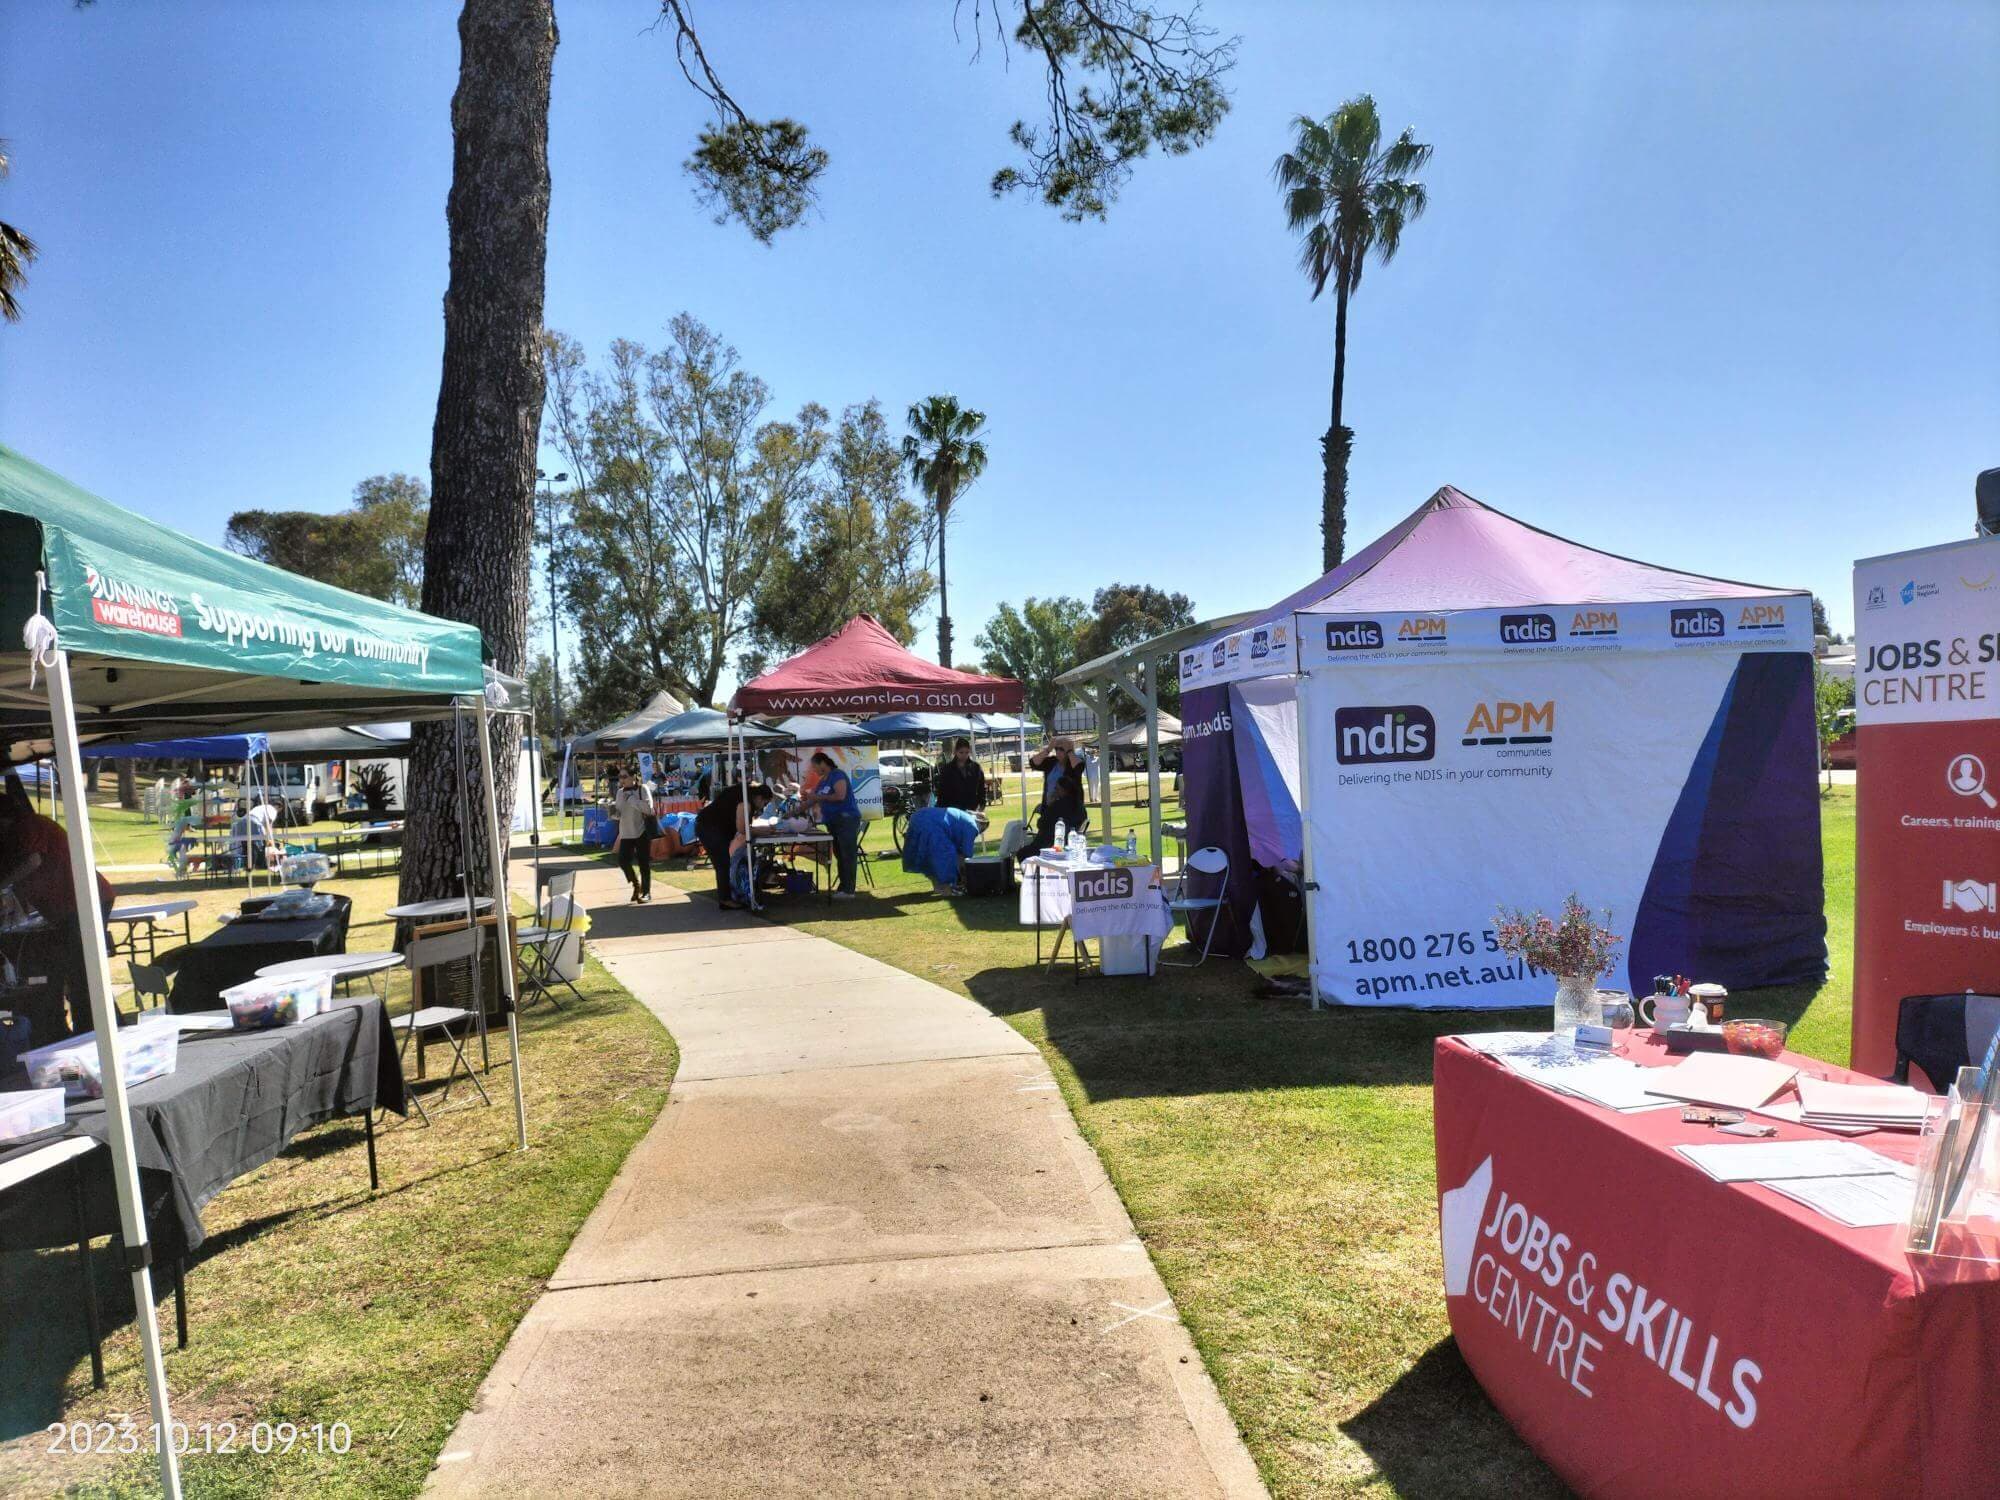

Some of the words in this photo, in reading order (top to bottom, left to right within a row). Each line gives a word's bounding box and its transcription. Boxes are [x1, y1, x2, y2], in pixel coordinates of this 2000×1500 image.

[98, 602, 178, 633] warehouse
[1571, 610, 1618, 629] APM
[1675, 611, 1721, 634] ndis
[1740, 605, 1784, 623] APM
[191, 592, 316, 658] Supporting
[320, 628, 349, 653] our
[353, 634, 429, 675] community
[1330, 624, 1379, 647] ndis
[1399, 618, 1446, 635] APM
[1504, 617, 1552, 641] ndis
[1864, 639, 1941, 673] JOBS
[1948, 638, 1971, 665] &
[1978, 632, 2000, 662] S
[768, 691, 994, 709] www.wanslea.asn.au
[1864, 671, 1986, 706] CENTRE
[1464, 701, 1555, 734] APM
[1343, 713, 1428, 756] ndis
[1496, 748, 1552, 758] communities
[1338, 772, 1391, 785] Delivering
[1393, 770, 1411, 782] the
[1415, 769, 1442, 781] NDIS
[1446, 769, 1456, 780] in
[1458, 768, 1484, 781] your
[1487, 765, 1553, 780] community
[1901, 815, 1952, 828] Careers,
[1078, 872, 1129, 898] ndis
[1076, 905, 1107, 914] Delivering
[1904, 920, 1968, 936] Employers
[1971, 925, 1979, 937] &
[1347, 936, 1416, 964] 1800
[1423, 931, 1475, 958] 276
[1482, 930, 1500, 953] 5
[1356, 955, 1556, 1000] apm.net.au/n
[1484, 1191, 1571, 1287] JOBS
[1568, 1252, 1597, 1314] &
[1597, 1272, 1763, 1429] SKILLS
[1474, 1253, 1603, 1399] CENTRE
